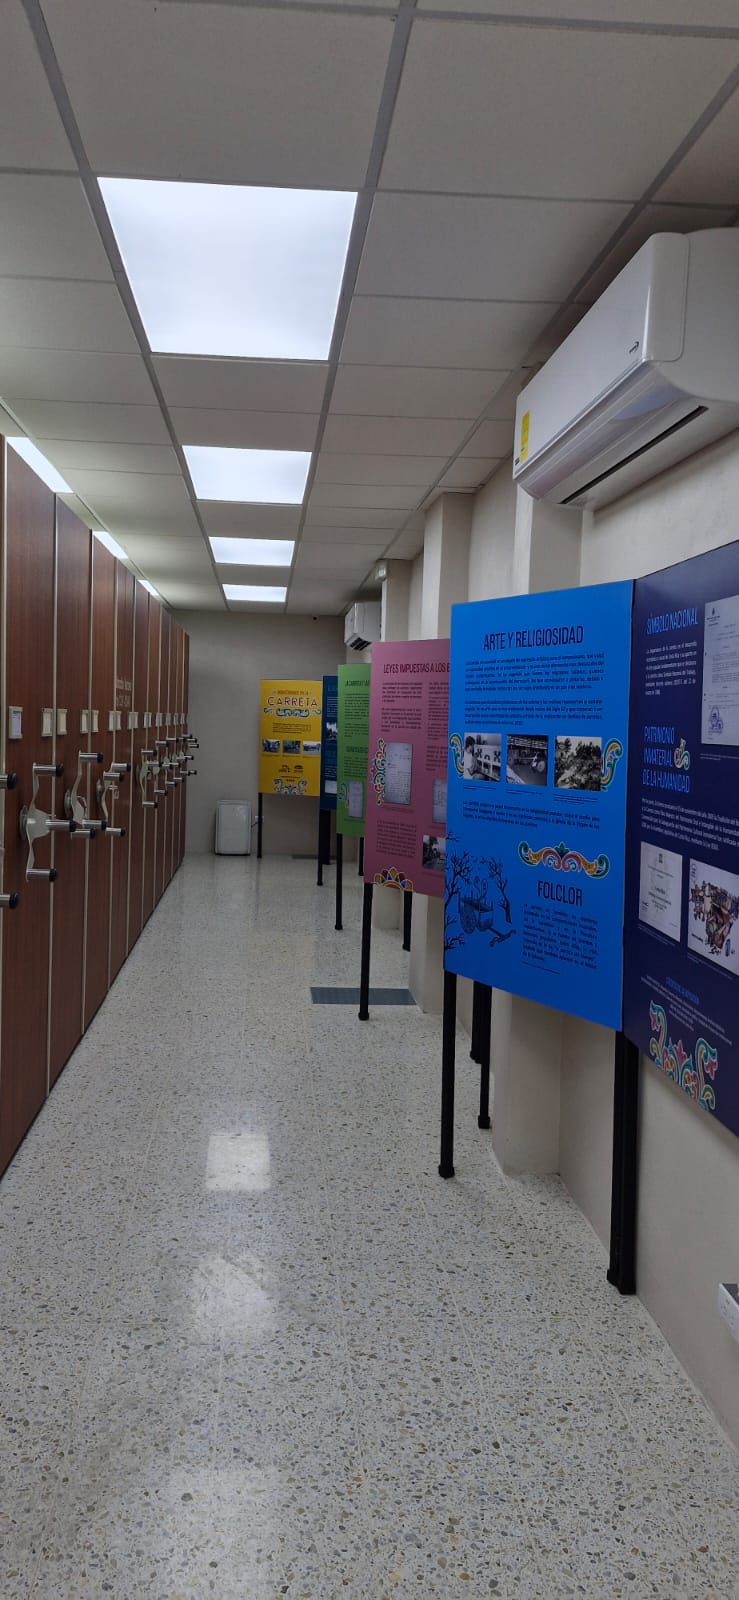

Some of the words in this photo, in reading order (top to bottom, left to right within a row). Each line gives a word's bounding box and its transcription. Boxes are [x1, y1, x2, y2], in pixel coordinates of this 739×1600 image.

[669, 607, 699, 630] NACIONAL
[483, 633, 505, 651] ARTE
[508, 632, 514, 649] Y
[515, 625, 584, 648] RELIGIOSIDAD
[383, 663, 399, 674] LEYES
[399, 663, 430, 673] IMPUESTAS
[430, 662, 434, 673] A
[435, 662, 446, 673] LOS
[267, 697, 318, 707] CARRETA
[644, 726, 675, 745] PATRIMONIO
[642, 769, 650, 786] DE
[650, 769, 657, 787] LA
[657, 771, 690, 793] HUMANIDAD
[538, 880, 583, 906] FOLCLOR
